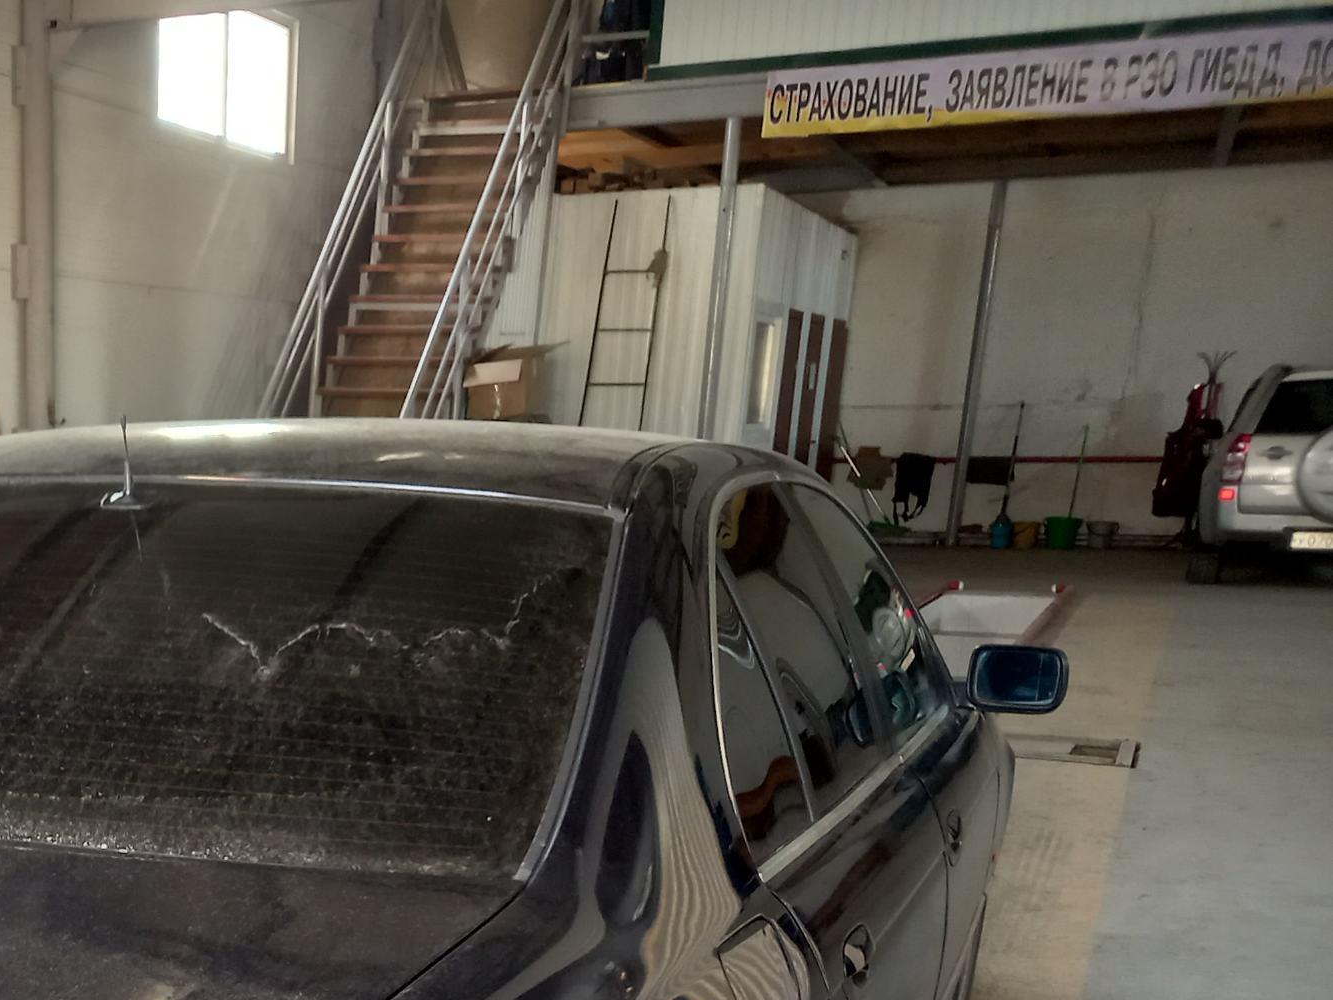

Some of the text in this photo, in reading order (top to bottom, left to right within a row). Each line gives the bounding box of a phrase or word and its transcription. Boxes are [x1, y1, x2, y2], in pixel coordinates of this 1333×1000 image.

[769, 73, 933, 124] СТРАХОВАНИЕ,
[945, 58, 1094, 113] ЗАЯВЛЕНИЕ
[1100, 57, 1119, 102] В
[1123, 49, 1178, 99] РЭО
[1186, 40, 1285, 98] ГИБДД,
